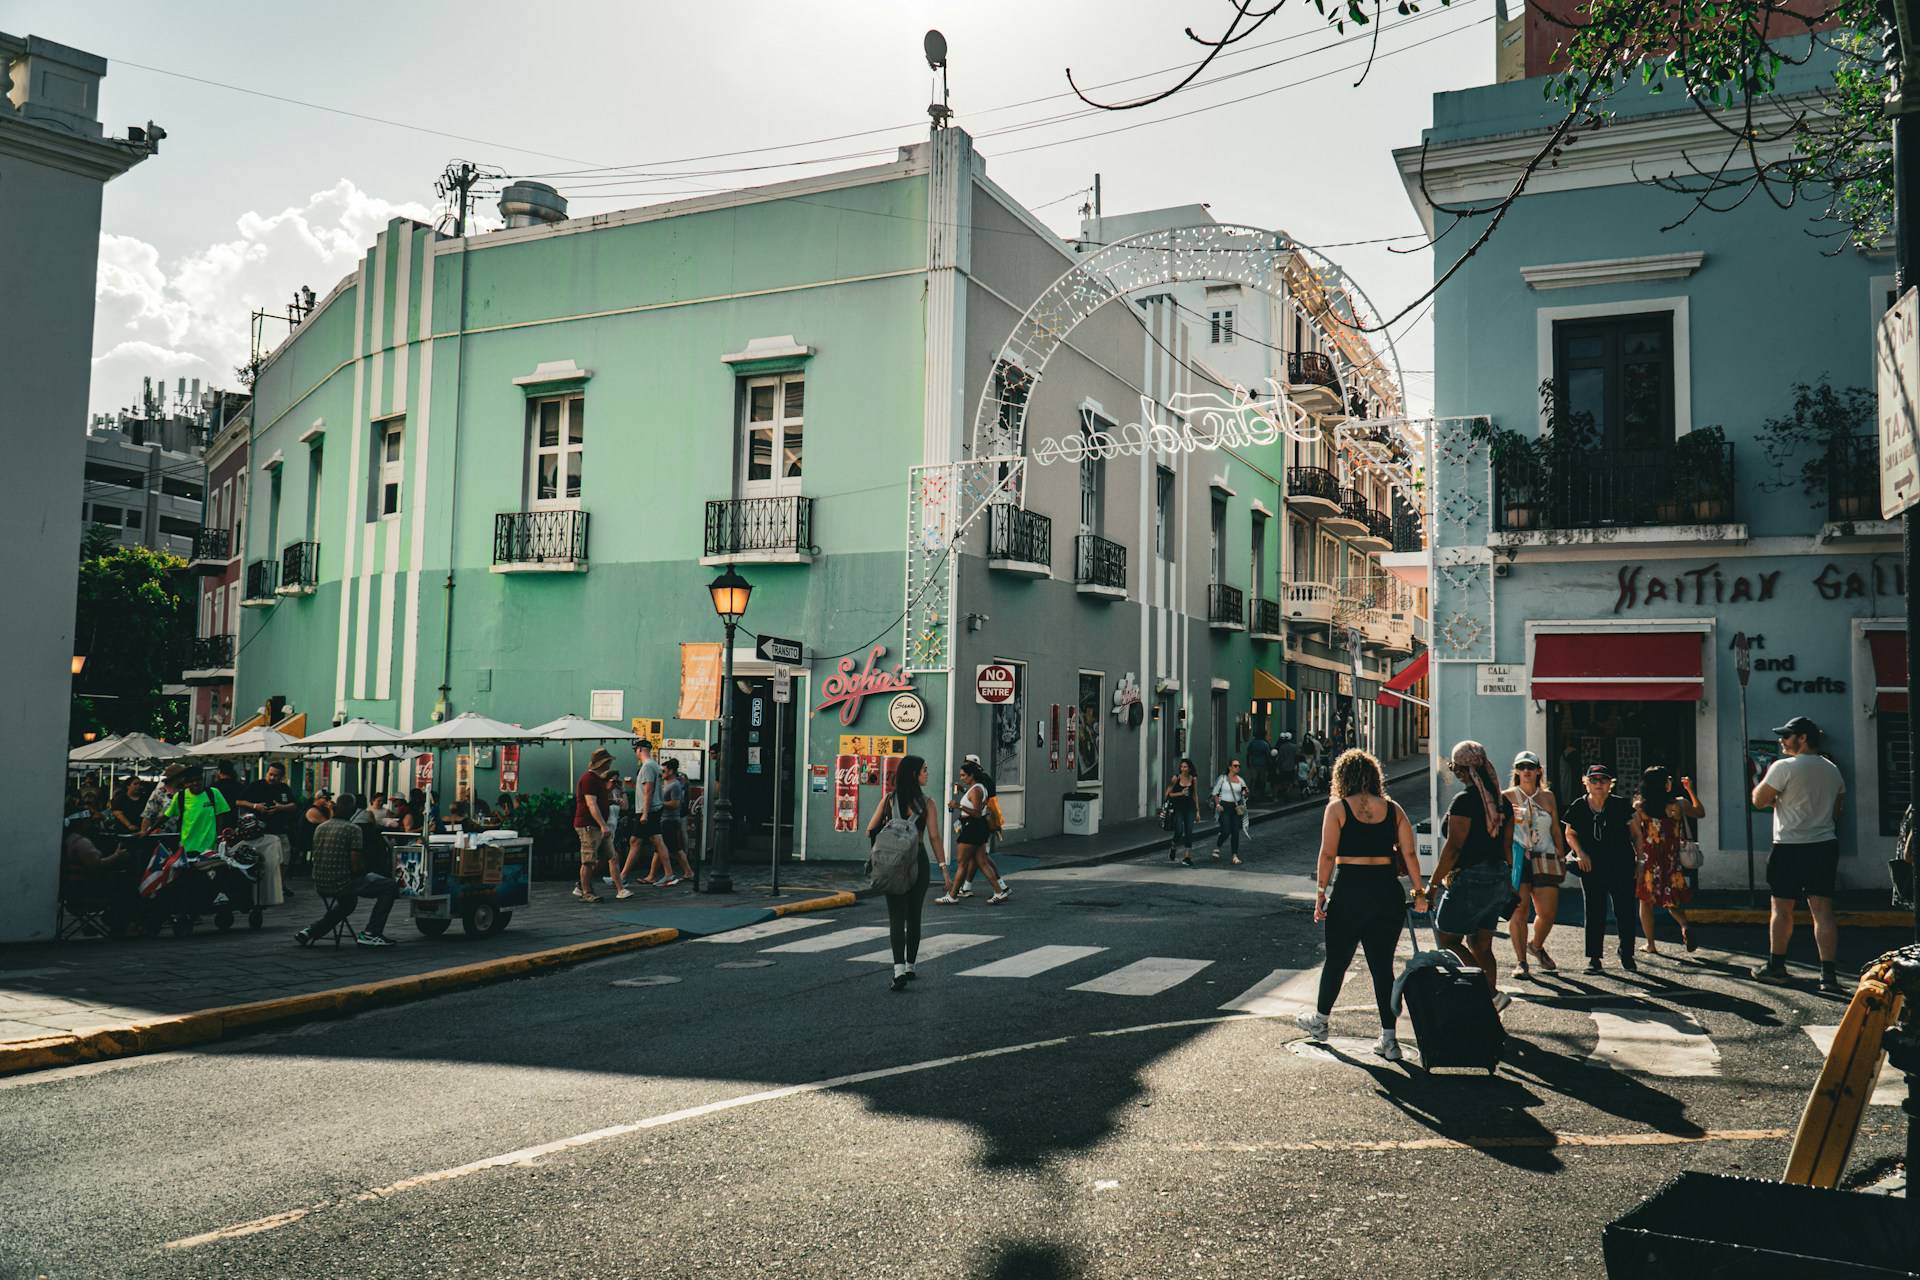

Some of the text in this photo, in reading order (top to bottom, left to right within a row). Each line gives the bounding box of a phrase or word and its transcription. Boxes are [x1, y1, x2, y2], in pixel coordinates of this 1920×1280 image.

[772, 645, 798, 658] TRANSITO
[1754, 655, 1795, 672] and
[778, 668, 787, 679] NO
[986, 669, 1006, 681] NO
[816, 644, 915, 726] Sofia's
[981, 688, 1010, 697] ENTRE
[1777, 677, 1846, 694] Crafts
[752, 700, 761, 724] OPEN
